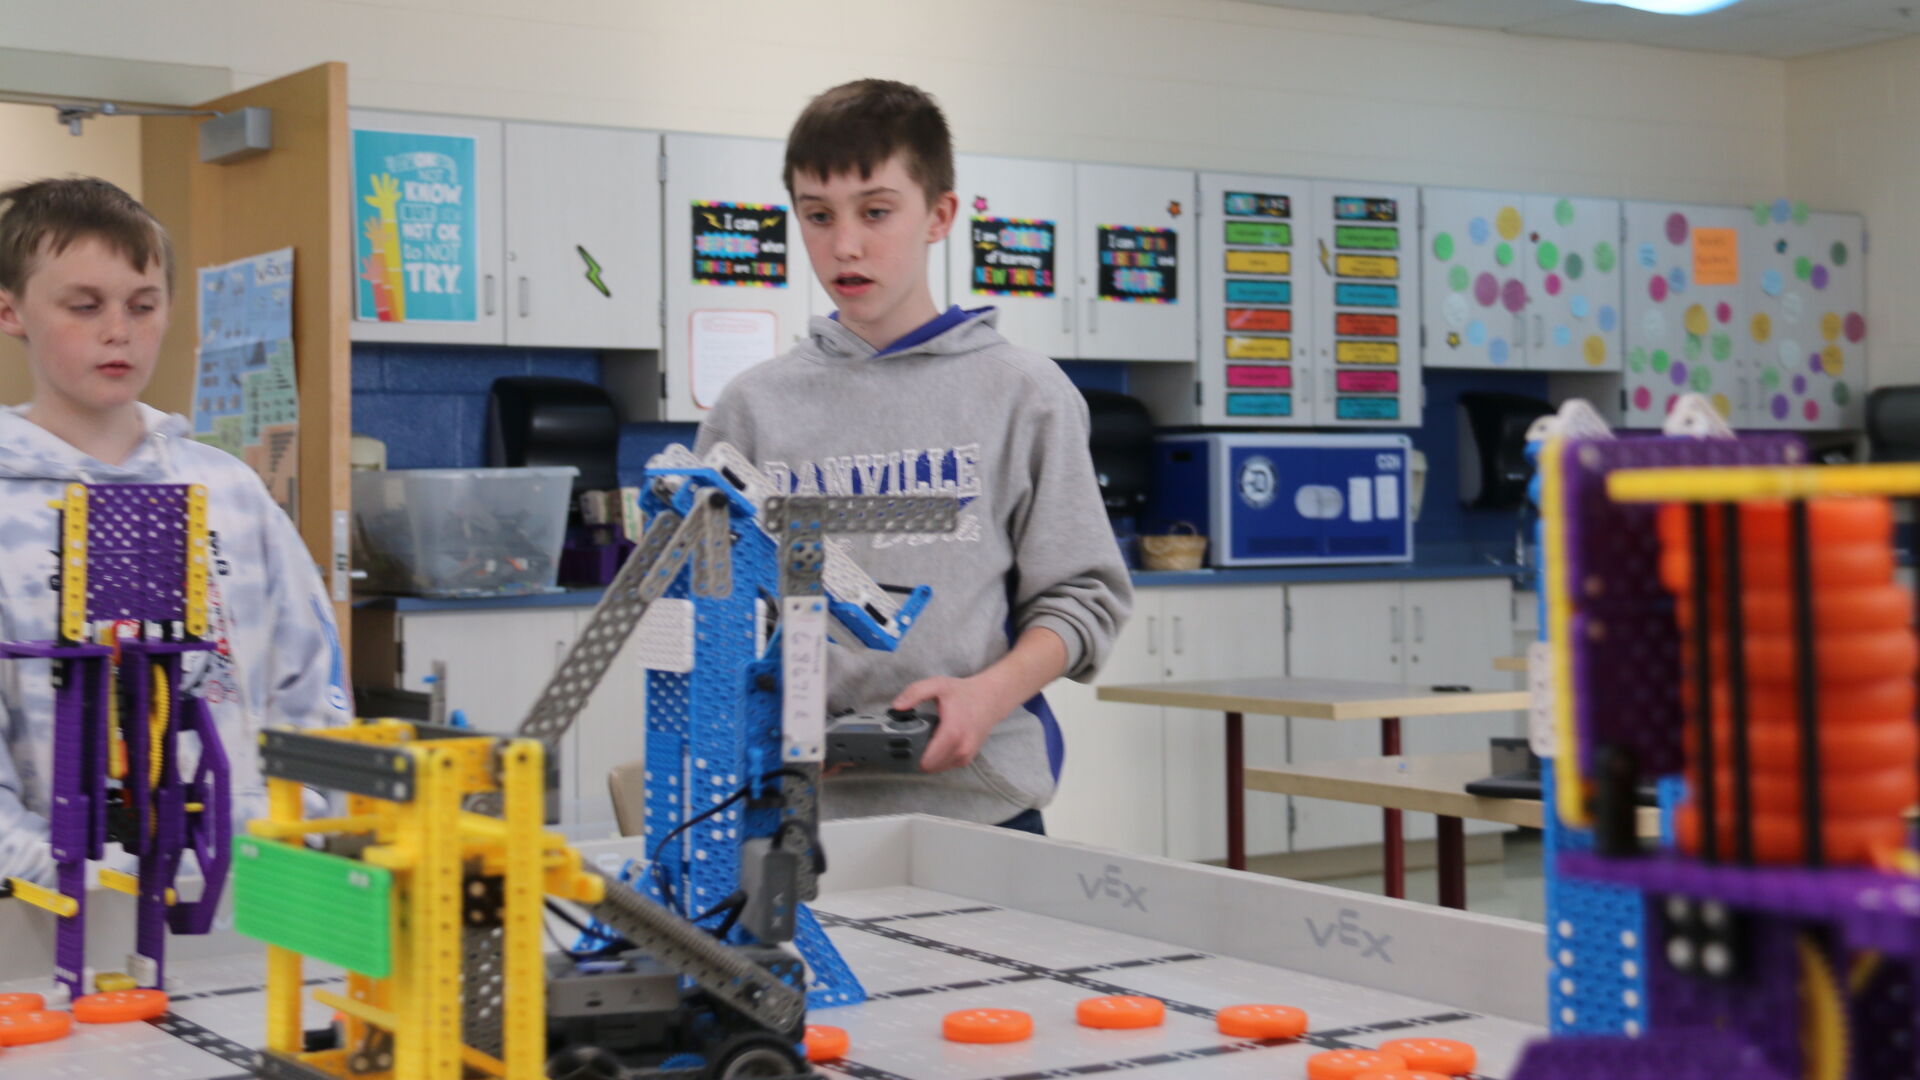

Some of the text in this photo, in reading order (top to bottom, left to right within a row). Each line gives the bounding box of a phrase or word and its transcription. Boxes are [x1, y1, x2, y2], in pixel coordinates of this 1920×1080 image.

[404, 181, 463, 206] KNOW
[402, 224, 462, 241] NOT OK
[723, 213, 733, 231] I
[975, 265, 1006, 286] NEW
[763, 442, 983, 498] DANVILLE
[1076, 863, 1149, 914] VEX
[1304, 907, 1395, 964] VEX
